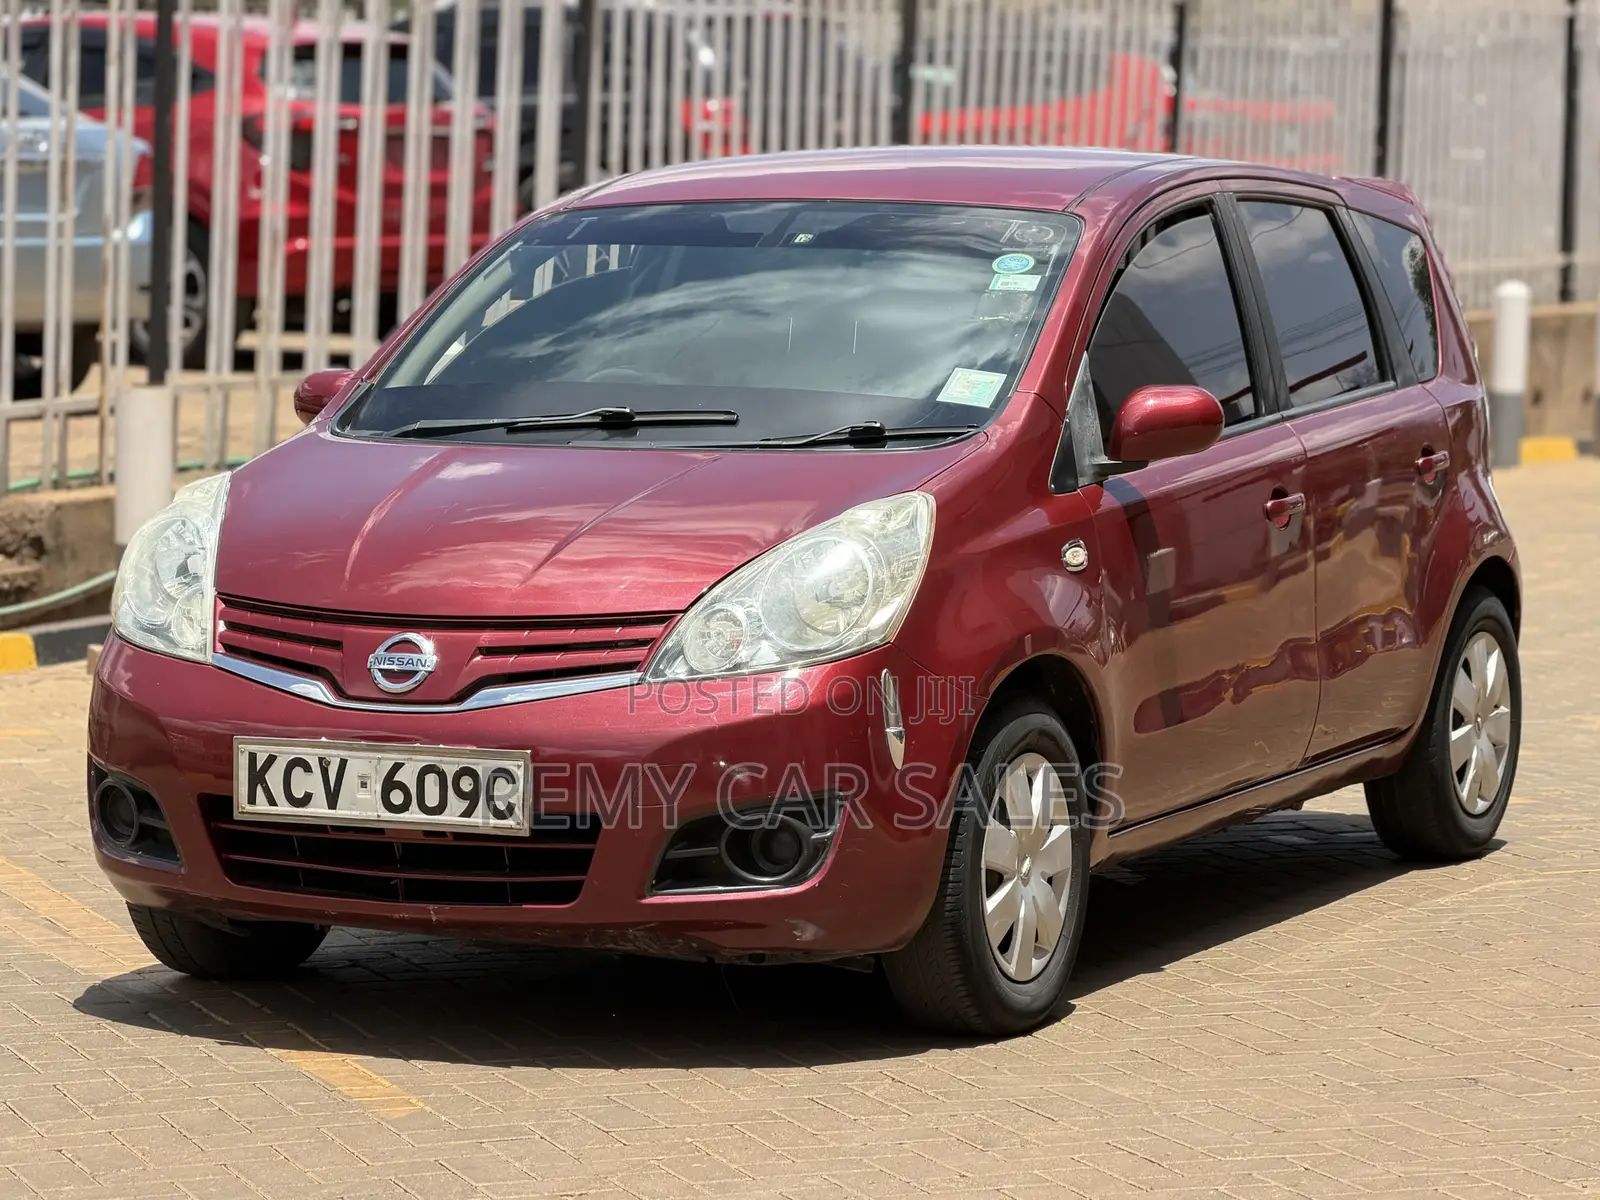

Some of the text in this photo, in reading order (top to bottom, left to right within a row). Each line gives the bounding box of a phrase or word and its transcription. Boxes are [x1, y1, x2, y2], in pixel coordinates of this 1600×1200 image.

[373, 656, 427, 668] NISSAN
[247, 752, 517, 821] KCV 609C
